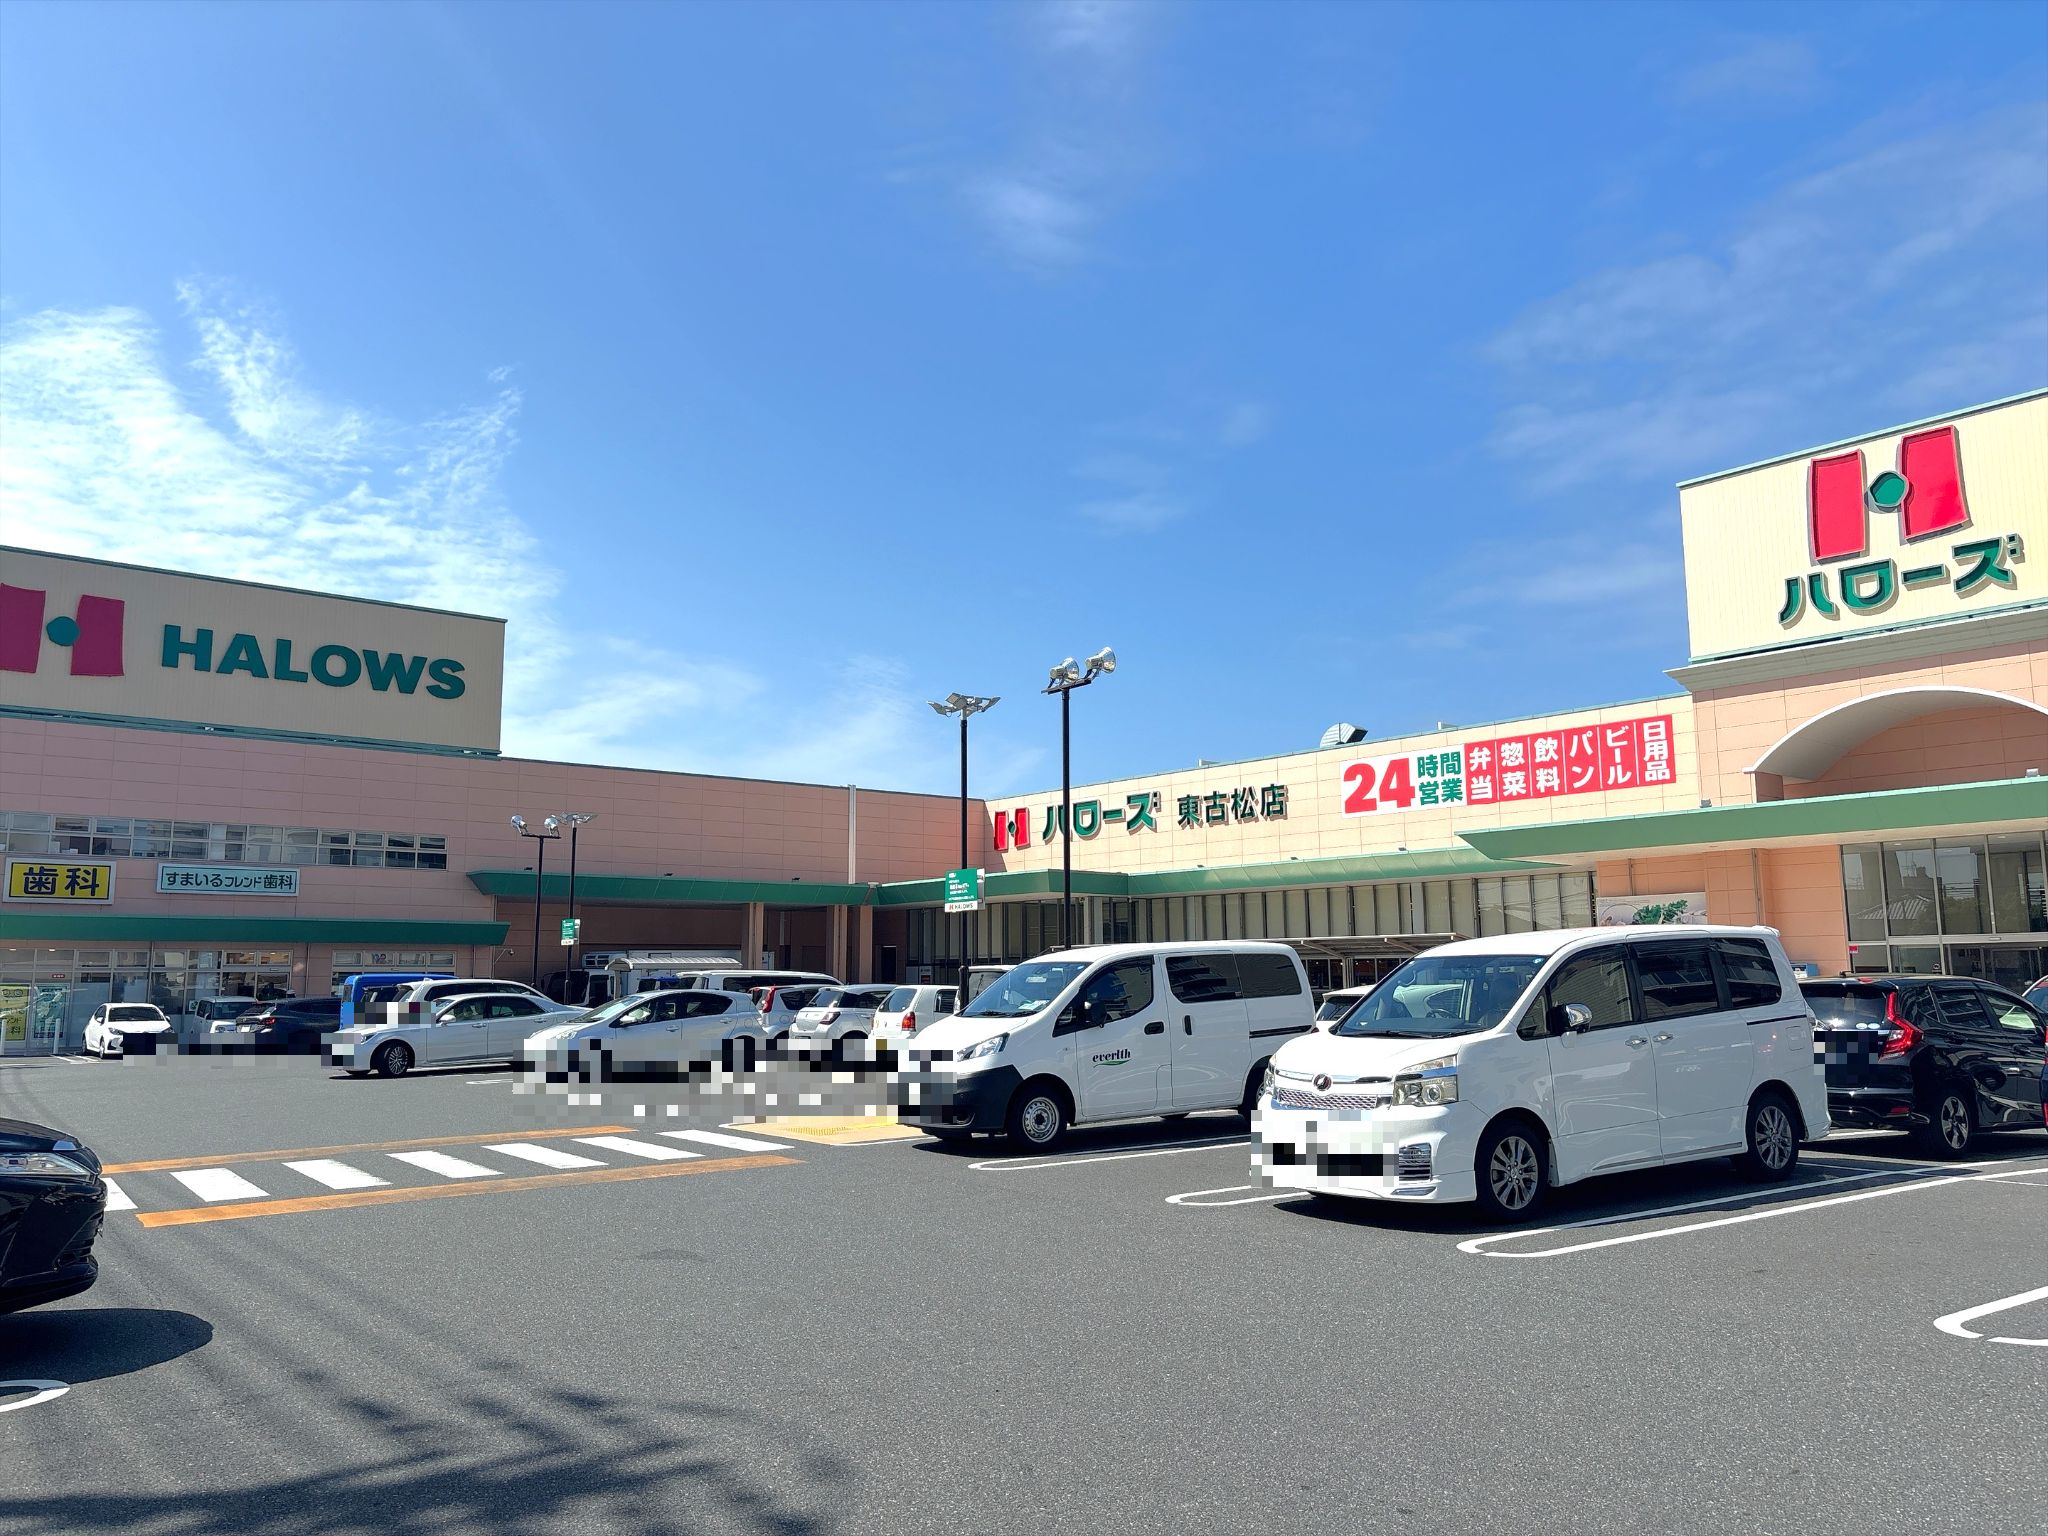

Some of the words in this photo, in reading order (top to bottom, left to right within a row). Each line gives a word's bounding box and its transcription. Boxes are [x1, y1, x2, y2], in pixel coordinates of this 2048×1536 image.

[1778, 533, 2022, 627] ハローズ
[161, 623, 466, 700] HALOWS
[1468, 746, 1494, 800] 弁当
[1500, 742, 1527, 797] 惣菜
[1533, 737, 1561, 793] 飲料
[1568, 730, 1595, 789] パン
[1606, 725, 1632, 786] ビール
[1642, 720, 1672, 782] 日用品
[1343, 757, 1415, 813] 24
[1417, 750, 1462, 779] 時間
[1418, 777, 1464, 806] 営業
[1042, 792, 1160, 842] ハローズ
[1177, 783, 1288, 828] 東古松店
[23, 866, 100, 897] 歯科
[165, 871, 294, 891] すまいるフレンド歯科
